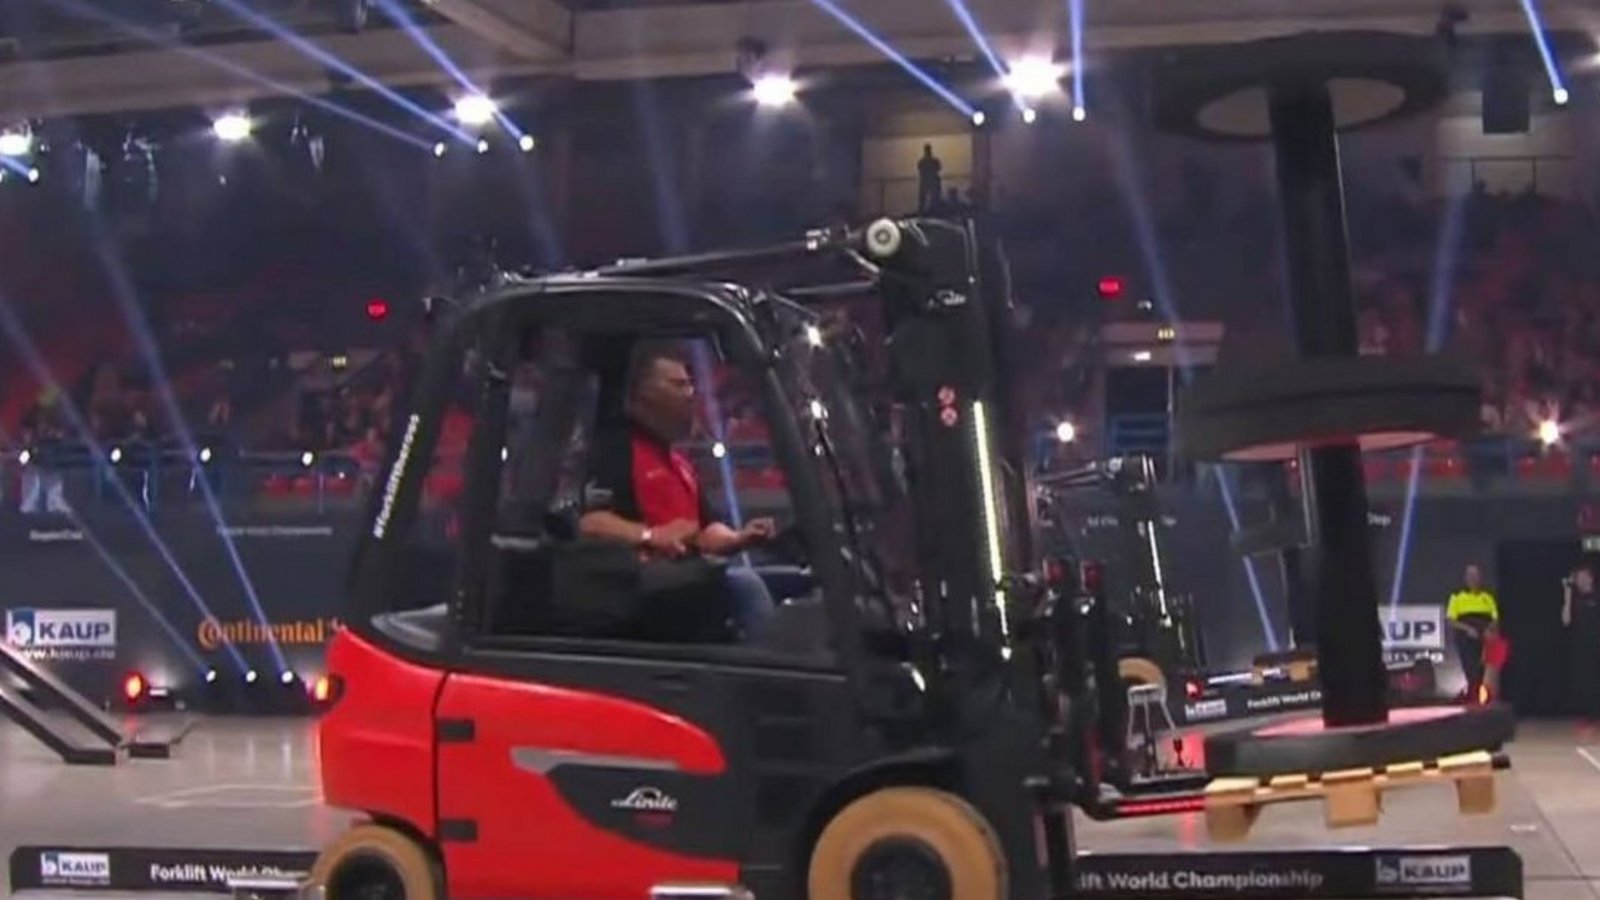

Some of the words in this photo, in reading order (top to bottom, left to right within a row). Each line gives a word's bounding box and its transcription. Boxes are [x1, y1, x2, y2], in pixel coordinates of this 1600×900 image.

[39, 622, 111, 640] KAUP
[198, 616, 324, 649] Continental
[1389, 621, 1436, 641] UP
[150, 863, 208, 881] Forklift
[1107, 870, 1169, 890] World
[1172, 869, 1324, 891] Championship
[1404, 864, 1466, 880] KAUP
